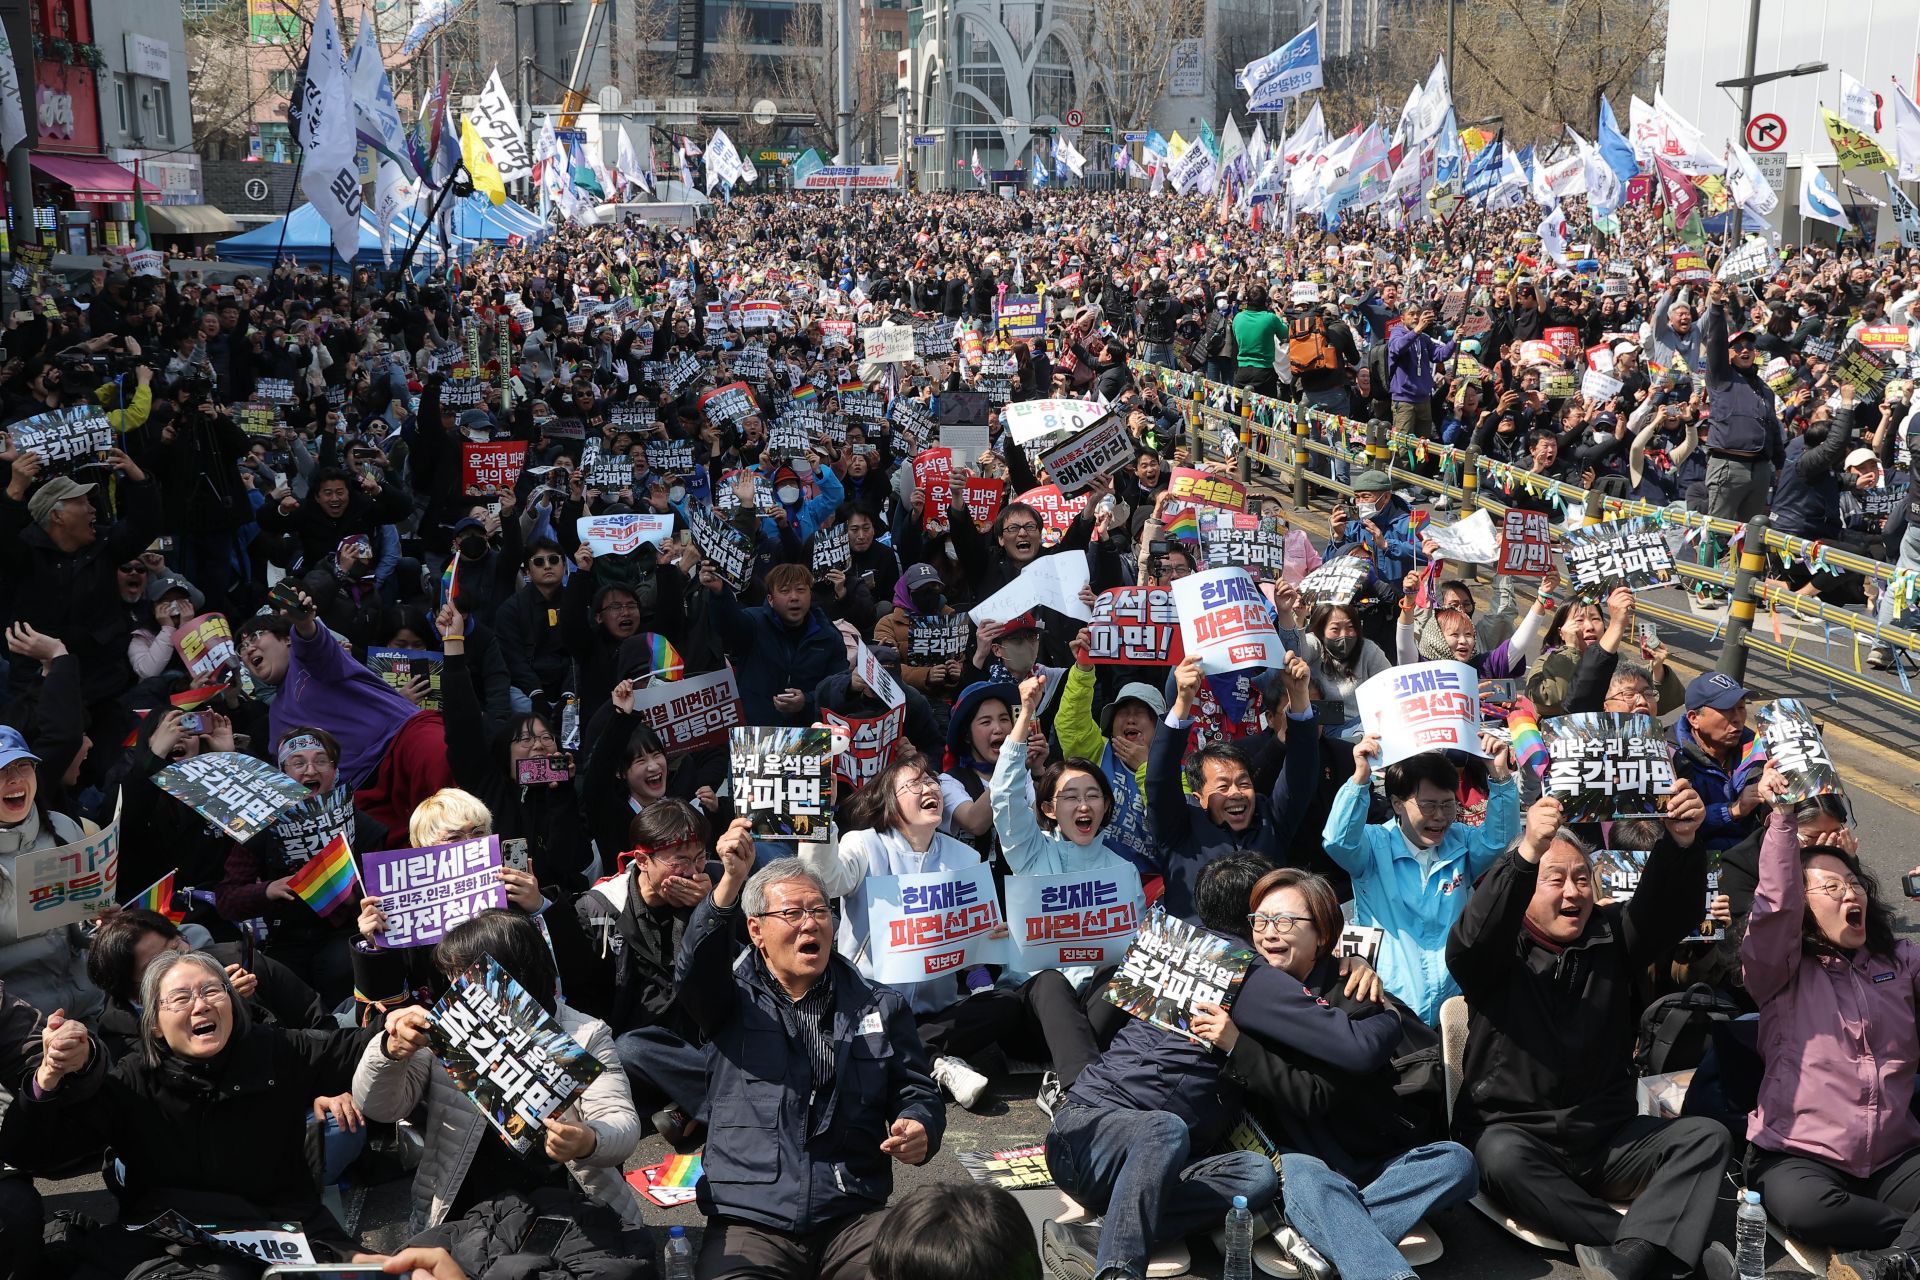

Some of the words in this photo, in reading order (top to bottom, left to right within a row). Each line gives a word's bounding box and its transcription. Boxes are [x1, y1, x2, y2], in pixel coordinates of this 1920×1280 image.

[760, 151, 800, 161] SUBWAY
[1772, 155, 1785, 166] 거리
[805, 175, 848, 188] 내란세력
[848, 175, 889, 187] 완전청산!
[440, 392, 481, 406] 즉각파면
[709, 398, 751, 426] 즉각파면
[845, 405, 883, 418] 즉각파면
[72, 415, 110, 437] 윤석열
[610, 412, 656, 425] 즉각파면
[893, 409, 931, 439] 즉각파면
[769, 434, 811, 452] 즉각파면
[468, 452, 508, 469] 윤석열
[509, 451, 526, 467] 파면
[612, 462, 633, 473] 윤석열
[647, 455, 693, 469] 즉각파면
[1050, 449, 1082, 471] 내란동조
[1056, 436, 1128, 487] 해체하라
[475, 468, 503, 485] 빛의
[973, 488, 998, 504] 파면
[1172, 476, 1245, 508] 윤석열을
[587, 520, 663, 540] 즉각파면!
[1208, 529, 1255, 543] 내란수괴
[1256, 530, 1283, 548] 윤석열
[1504, 510, 1550, 543] 윤석열
[690, 522, 744, 580] 즉각파면
[1207, 542, 1284, 571] 즉각파면
[1504, 543, 1550, 572] 파면!
[1570, 536, 1627, 564] 내란수괴
[1626, 531, 1662, 550] 윤석열
[919, 566, 932, 576] H
[1575, 546, 1673, 586] 즉각파면
[1091, 587, 1182, 625] 윤석열
[1200, 576, 1260, 610] 헌재는
[912, 633, 970, 657] 즉각파면
[913, 626, 950, 639] 내란수괴
[951, 623, 970, 637] 윤석열
[1088, 624, 1174, 661] 파면!
[1230, 643, 1265, 662] 진보당
[1711, 674, 1735, 689] W
[669, 680, 733, 720] 파면하고
[671, 702, 740, 744] 평등으로
[1416, 728, 1457, 747] 진보당
[1549, 737, 1624, 760] 내란수괴
[1627, 737, 1669, 760] 윤석열
[763, 753, 822, 776] 윤석열
[1548, 759, 1678, 797] 즉각파면
[178, 760, 278, 828] 즉각파면
[249, 777, 292, 810] 윤석열
[275, 808, 333, 839] 내란수괴
[377, 836, 493, 894] 내란세력
[901, 880, 979, 916] 헌재는
[1041, 879, 1118, 914] 헌재는
[889, 900, 999, 948] 파면선고!
[1025, 901, 1138, 943] 파면선고!
[927, 951, 963, 971] 진보당
[1062, 948, 1100, 962] 진보당
[1136, 930, 1186, 965] 내란수괴
[1185, 953, 1236, 991] 윤석열
[1122, 950, 1227, 1017] 즉각파면
[461, 981, 532, 1054] 내란수괴
[526, 1045, 580, 1100] 윤석열
[438, 999, 564, 1132] 즉각파면
